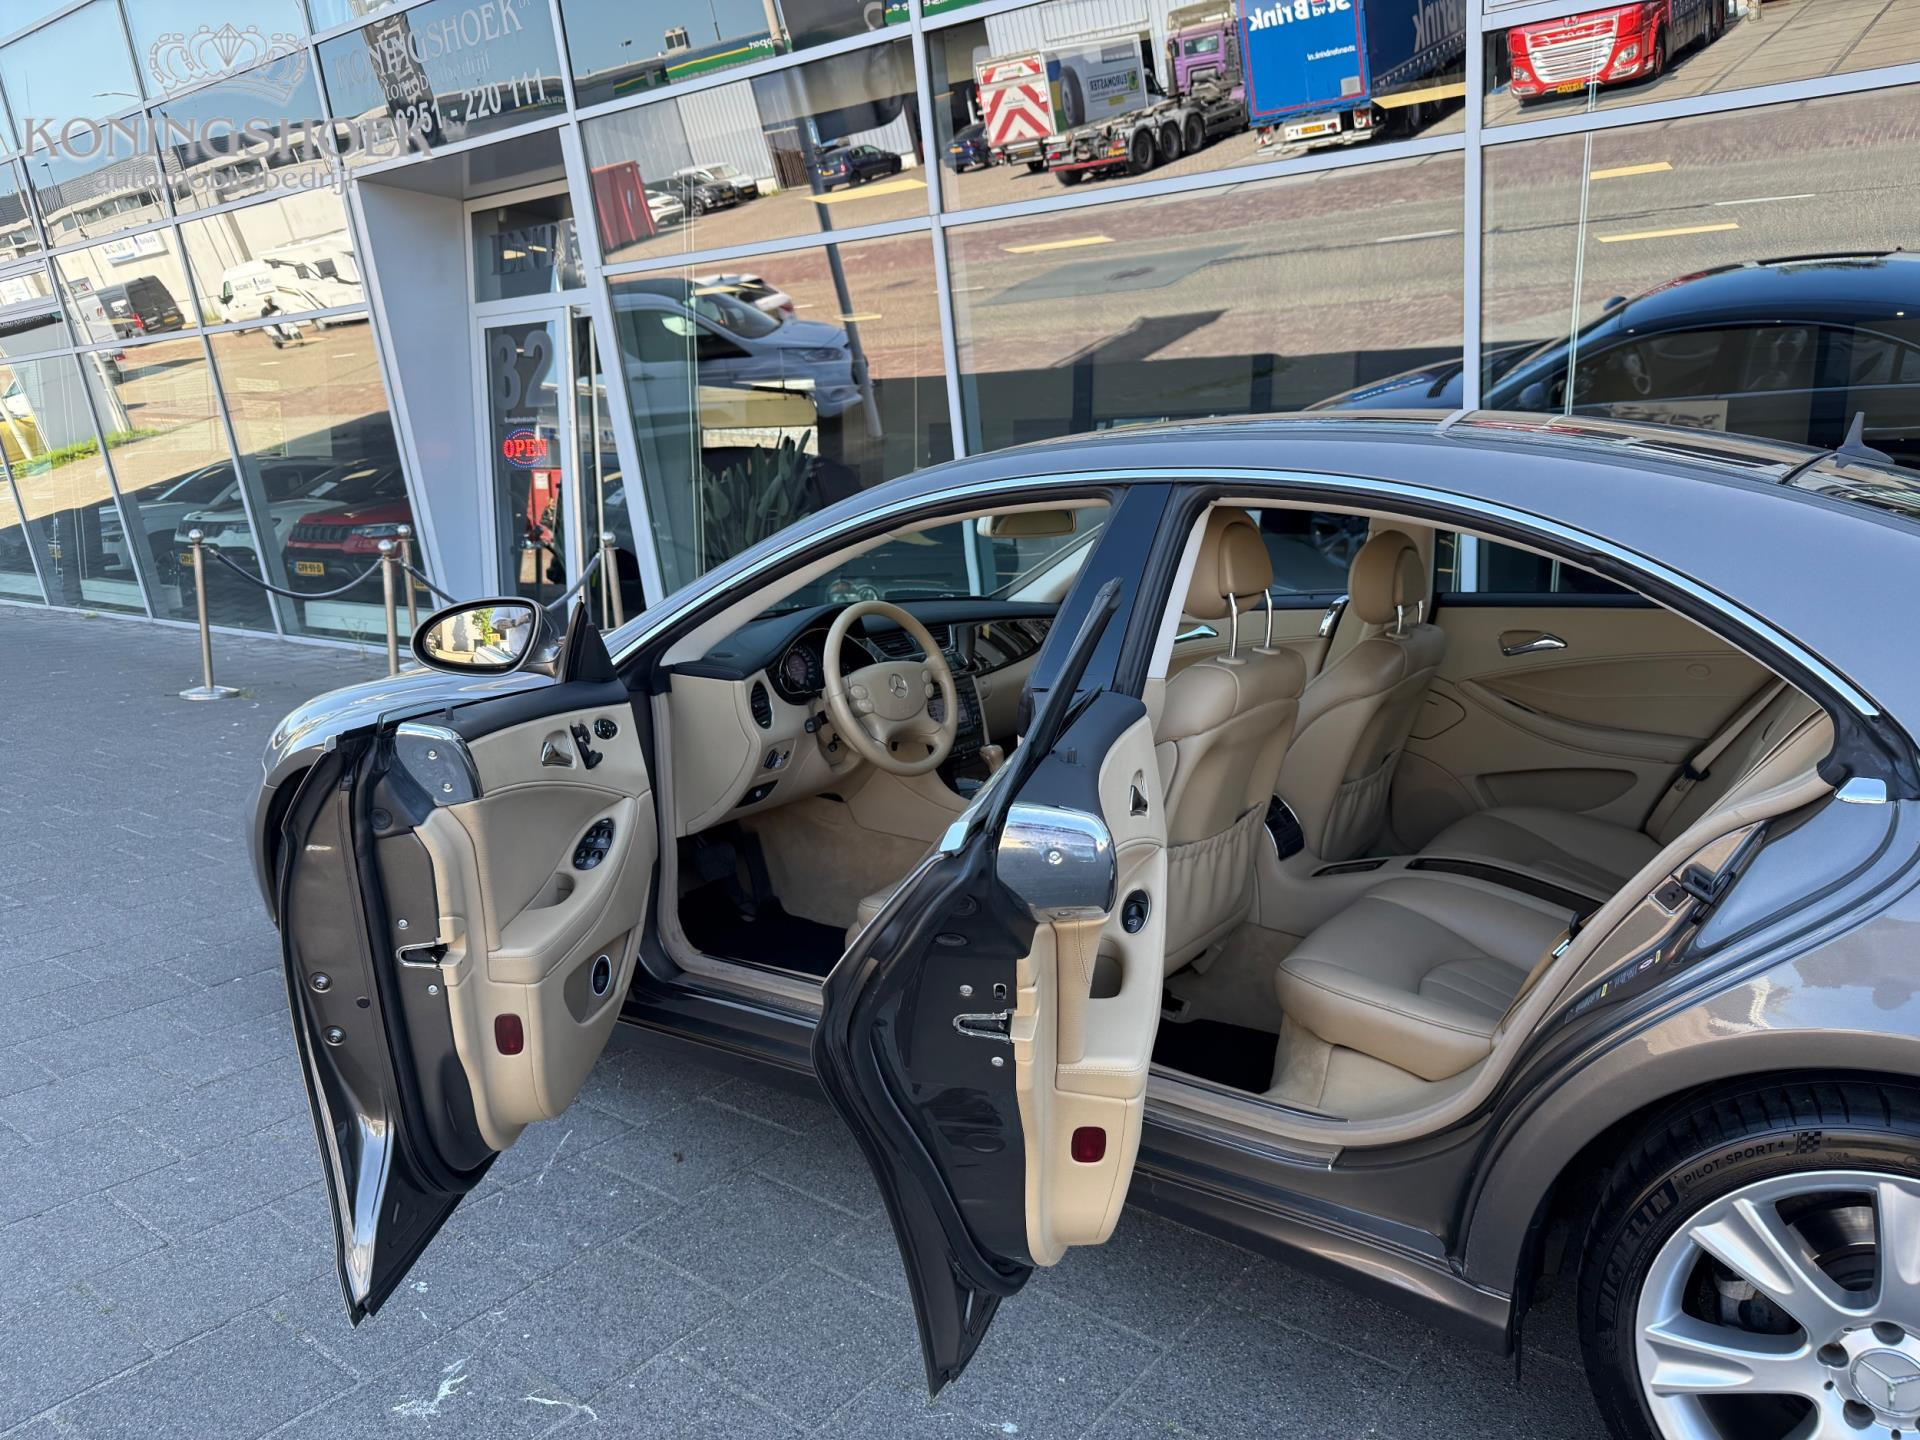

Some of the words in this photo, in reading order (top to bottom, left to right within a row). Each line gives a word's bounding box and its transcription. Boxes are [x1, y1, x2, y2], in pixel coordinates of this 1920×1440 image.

[461, 82, 502, 122] 220
[507, 67, 545, 108] 111
[503, 438, 547, 458] OPEN
[1683, 1159, 1721, 1185] PILOT
[1726, 1141, 1776, 1165] SPORT
[1777, 1140, 1785, 1149] 4
[1598, 1187, 1673, 1323] MICHELIN
